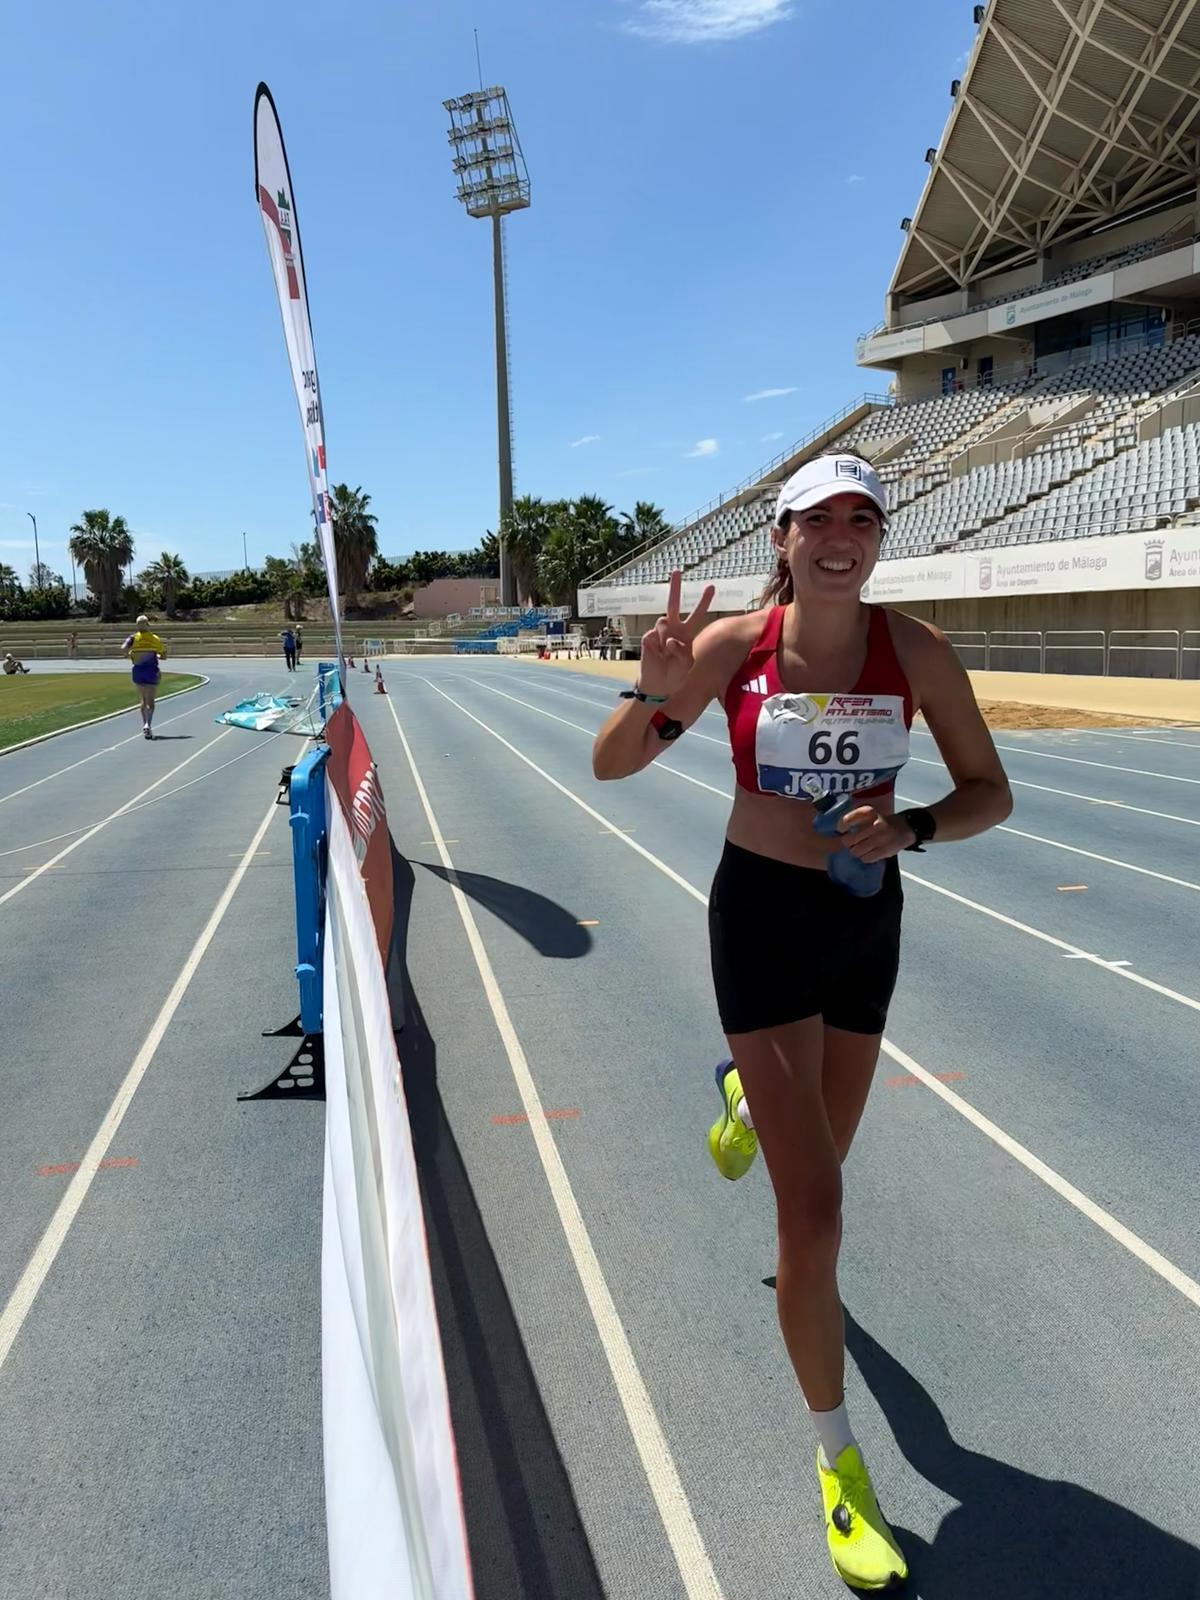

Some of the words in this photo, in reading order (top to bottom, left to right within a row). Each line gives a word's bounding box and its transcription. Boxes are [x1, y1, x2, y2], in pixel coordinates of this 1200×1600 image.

[996, 560, 1055, 578] Ayuntamiento
[1058, 558, 1069, 571] de
[825, 708, 893, 717] ATLETISMO
[808, 730, 860, 765] 66
